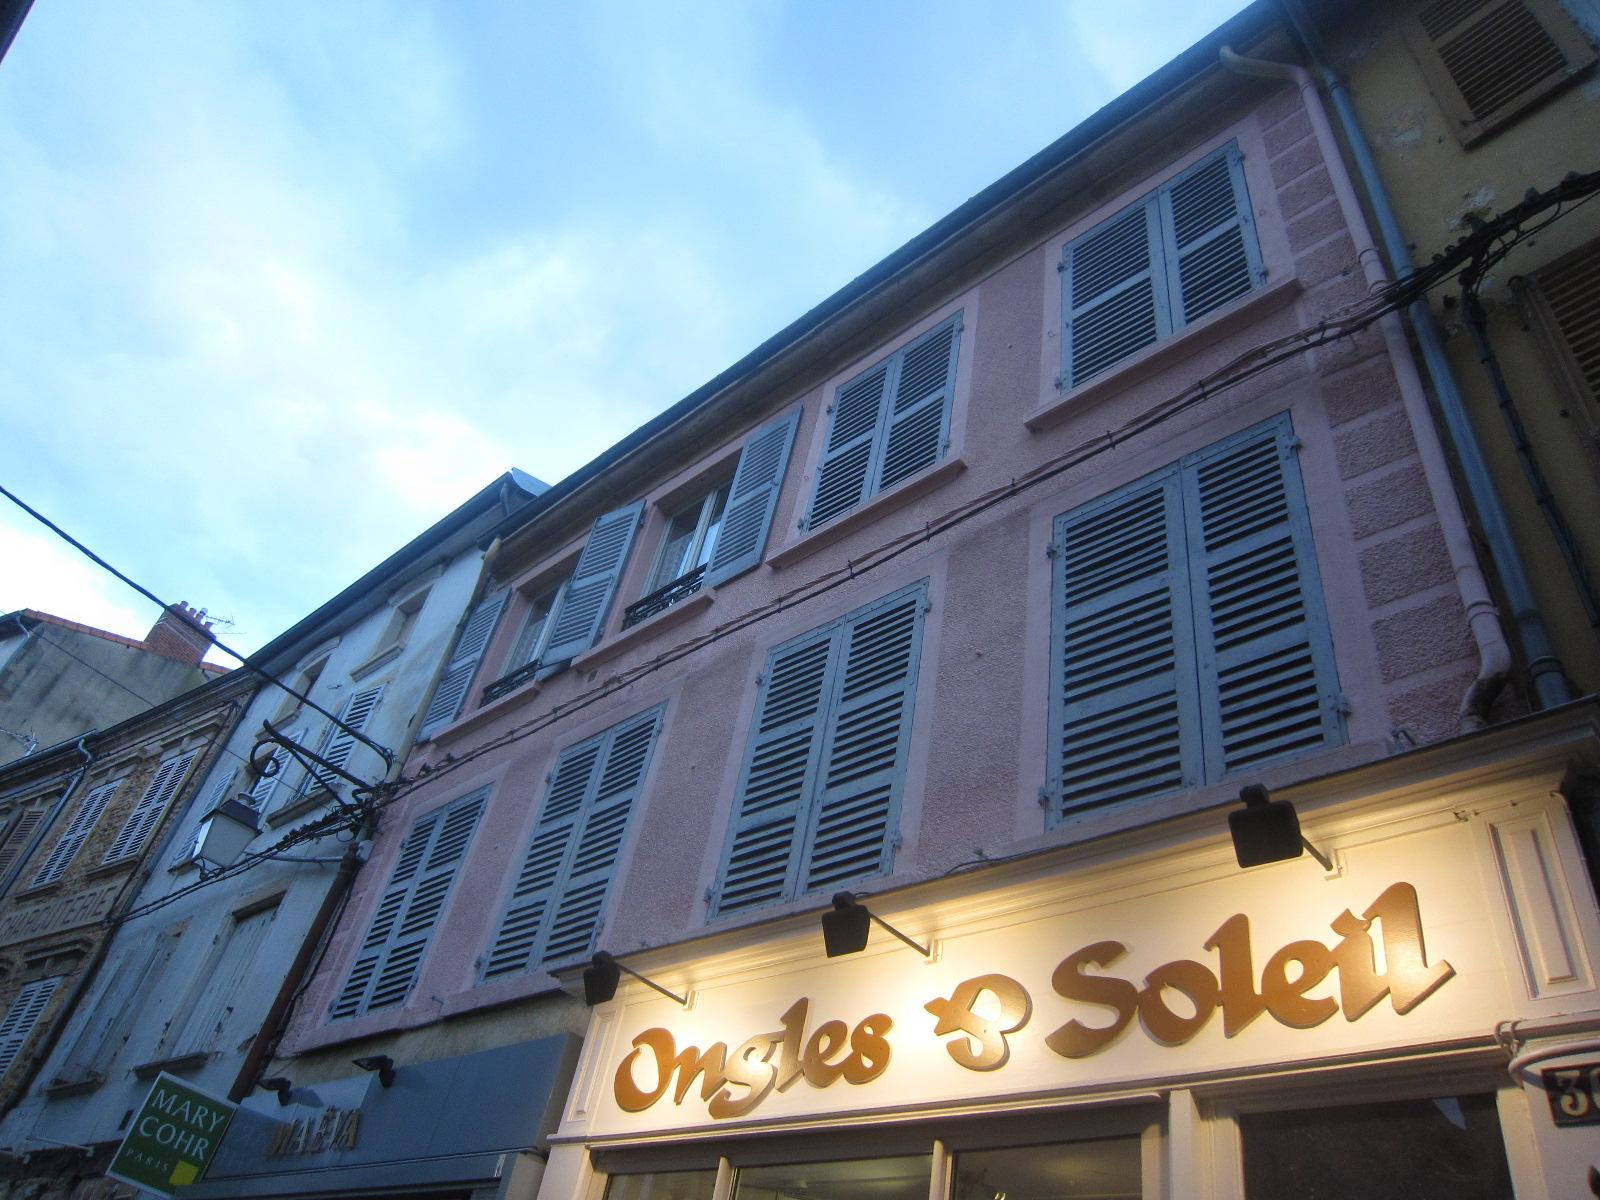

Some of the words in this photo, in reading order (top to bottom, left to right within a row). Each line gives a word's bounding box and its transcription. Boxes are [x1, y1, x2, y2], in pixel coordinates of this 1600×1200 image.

[613, 997, 894, 1120] Ongles
[1045, 881, 1456, 1059] Soleil
[152, 1089, 225, 1132] MARY
[140, 1116, 209, 1160] COHR
[127, 1148, 169, 1172] PARIS
